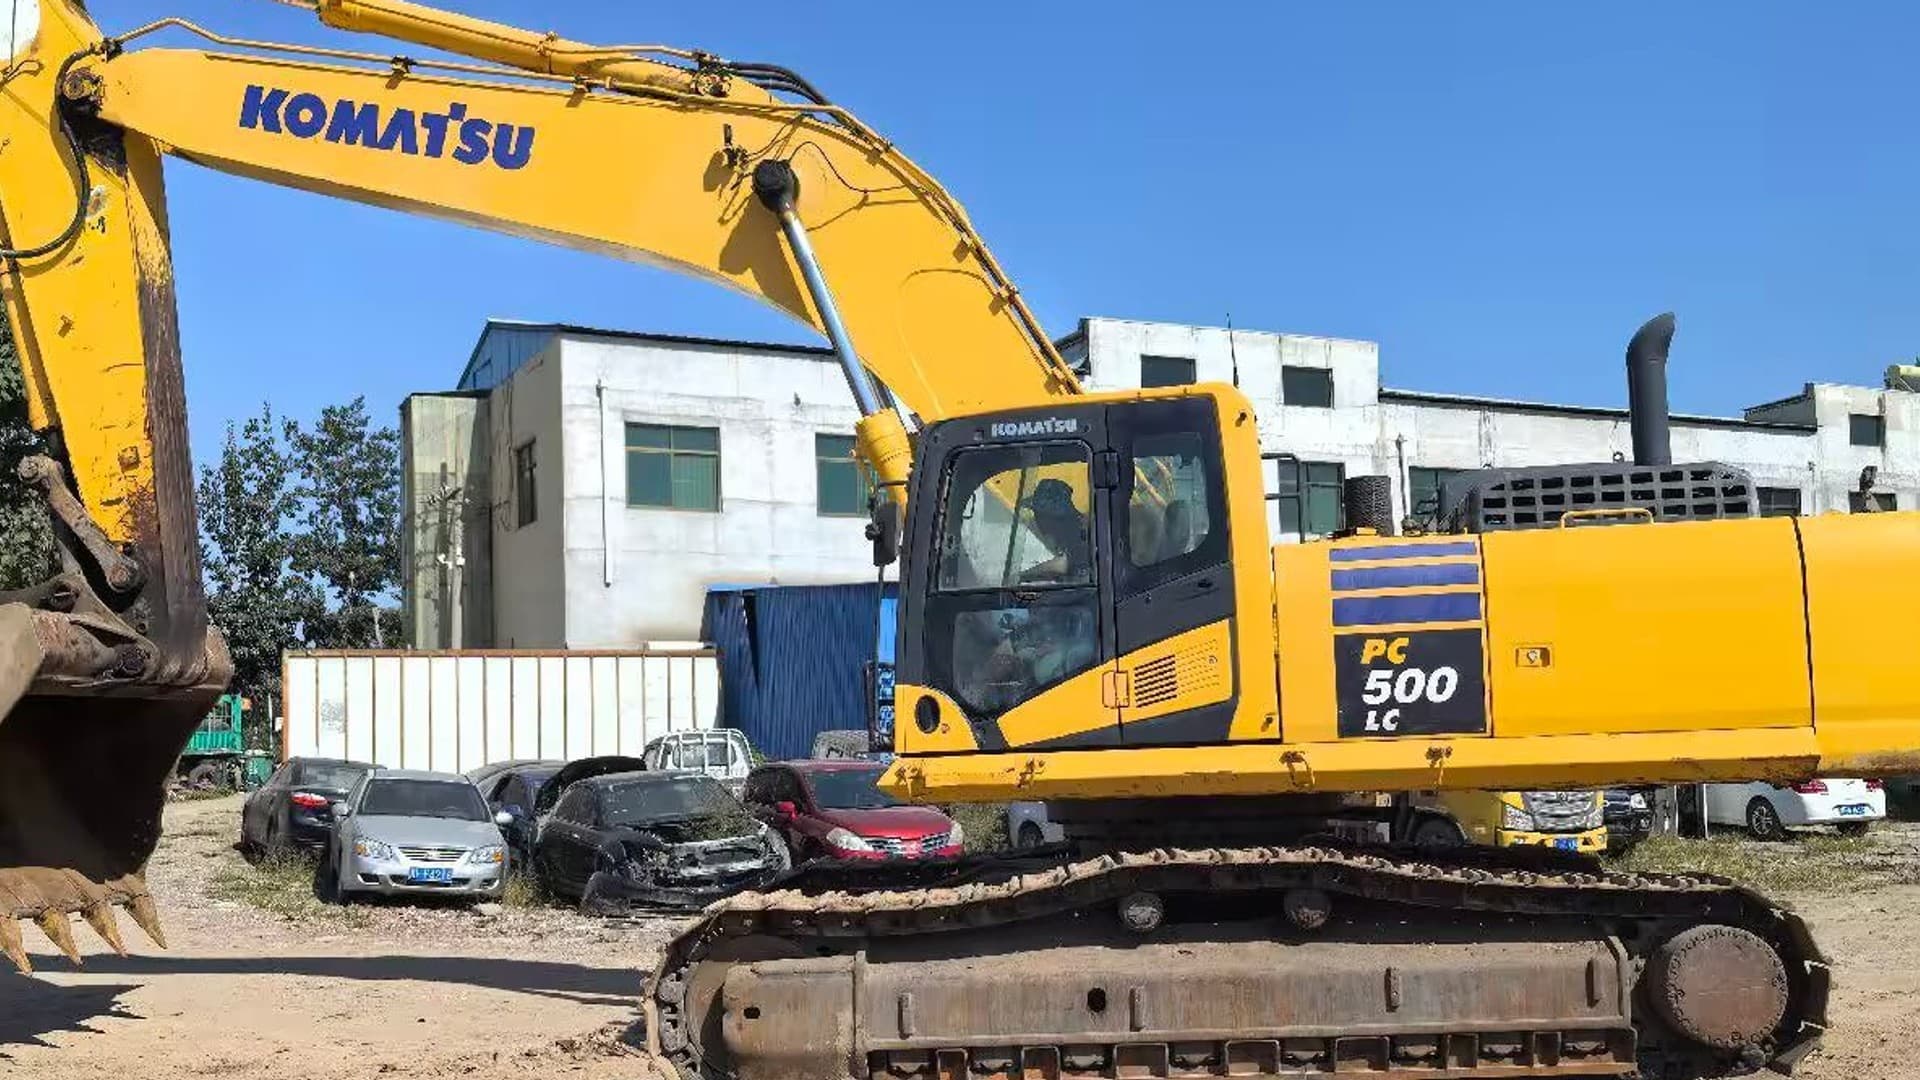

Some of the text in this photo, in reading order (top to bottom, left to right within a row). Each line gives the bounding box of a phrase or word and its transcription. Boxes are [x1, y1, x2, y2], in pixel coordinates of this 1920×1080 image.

[239, 84, 535, 170] KOMATSU
[991, 417, 1077, 437] KOMATSU
[1360, 637, 1410, 665] PC
[1362, 666, 1458, 705] 500
[1364, 708, 1400, 731] LC
